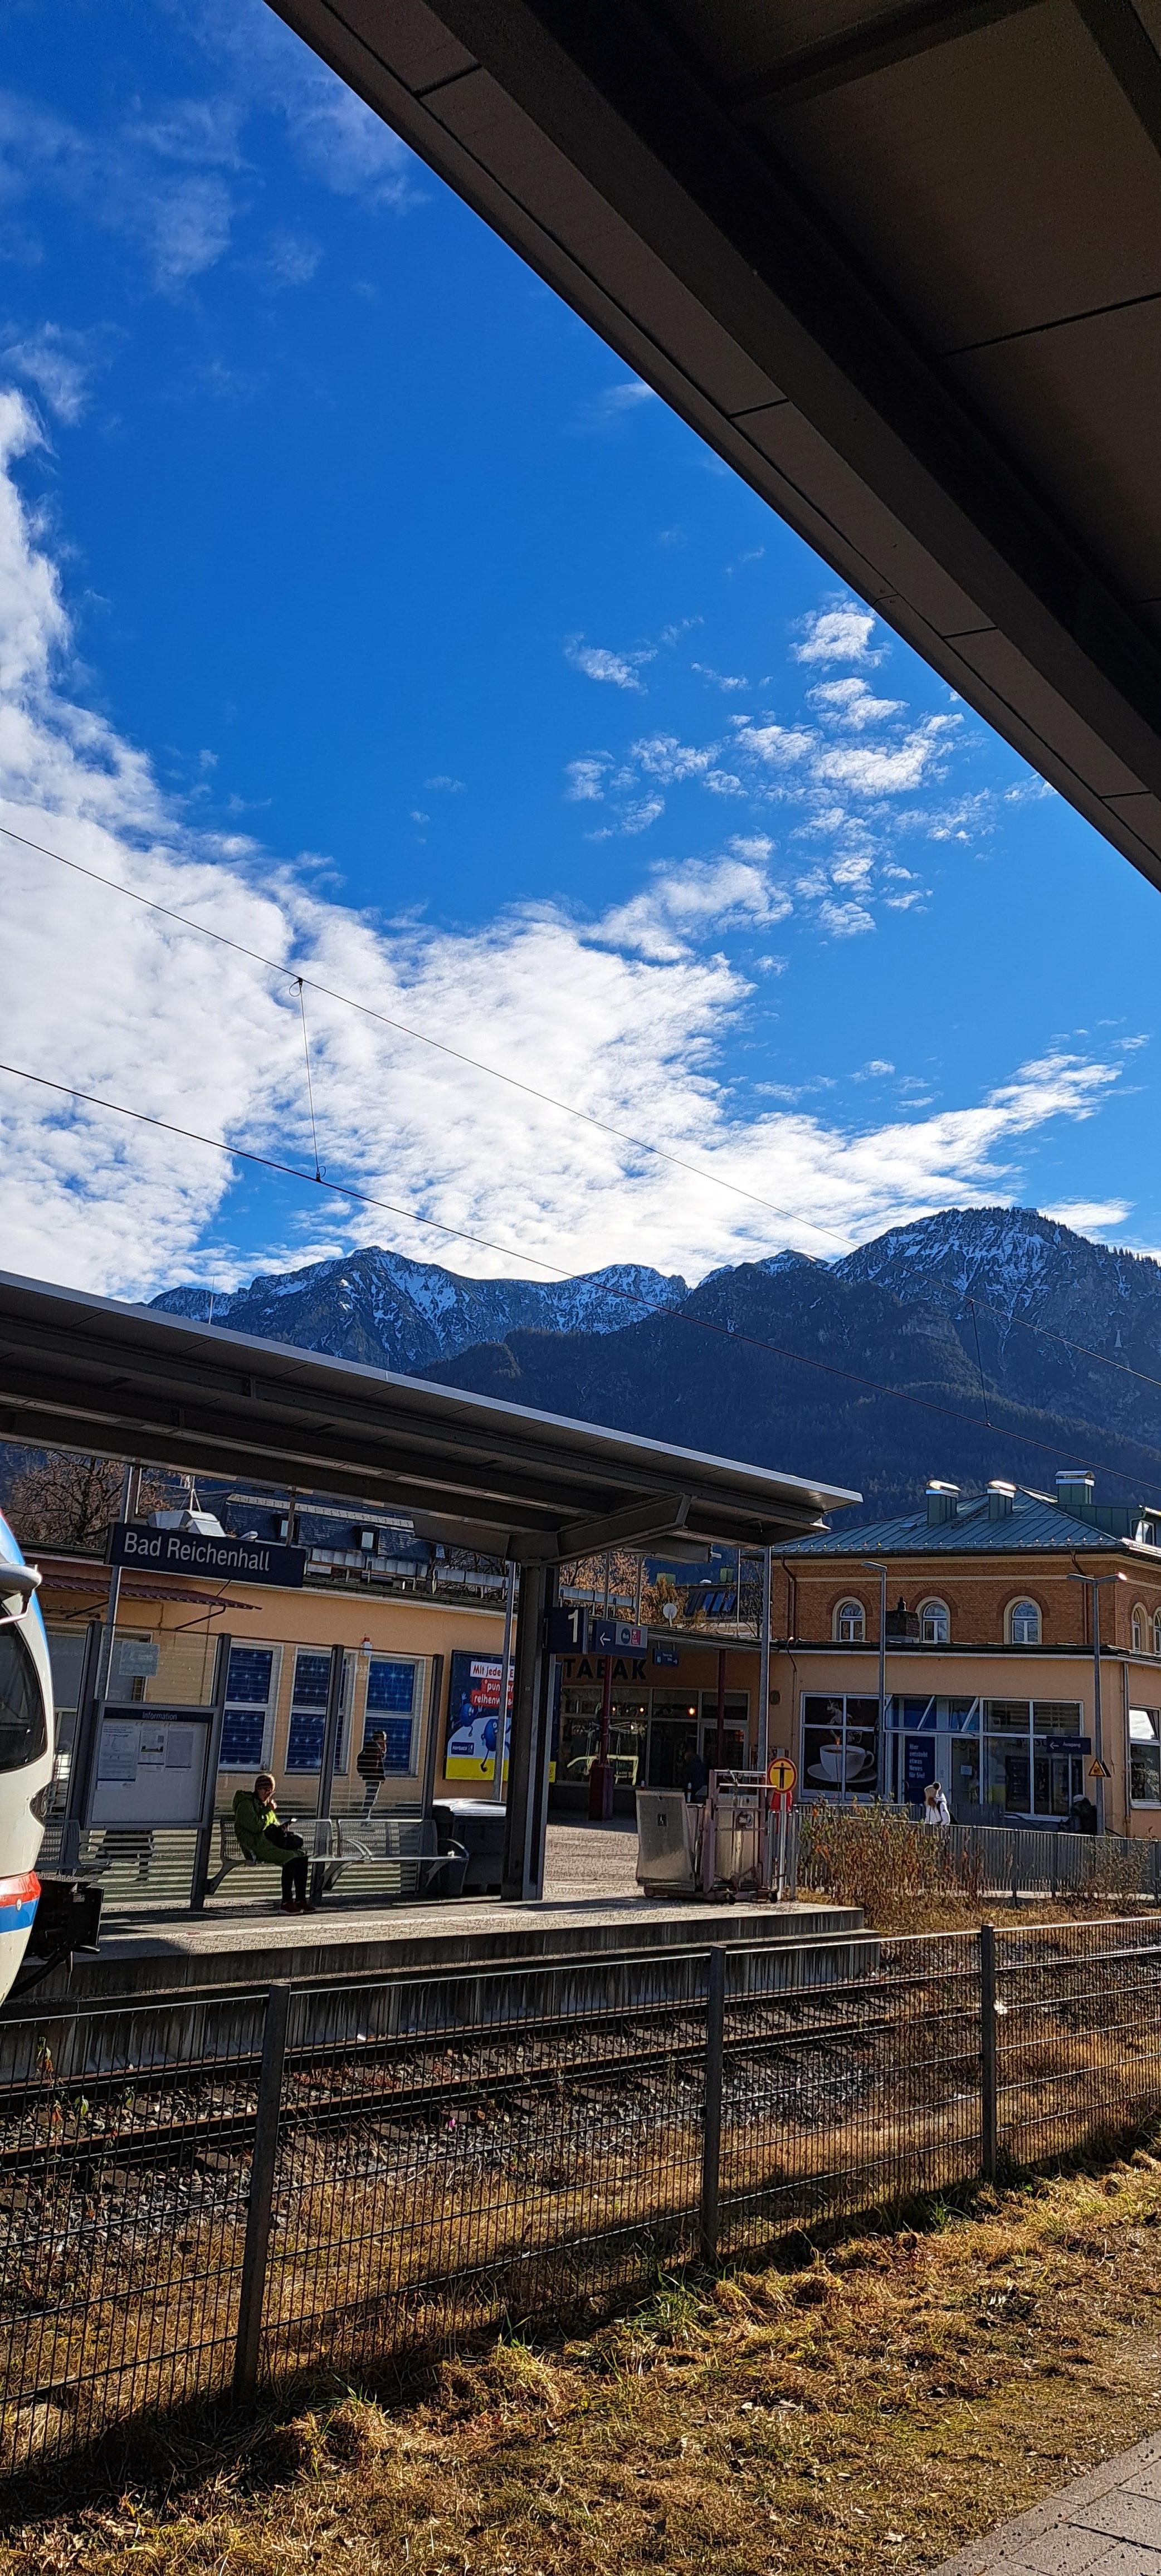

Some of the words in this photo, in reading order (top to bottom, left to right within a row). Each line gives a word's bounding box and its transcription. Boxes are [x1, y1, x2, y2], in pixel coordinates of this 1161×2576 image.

[123, 1532, 162, 1557] Bad
[167, 1538, 270, 1572] Reichenhall
[568, 1609, 579, 1643] 1
[472, 1665, 485, 1675] Mit
[142, 1711, 177, 1721] Information
